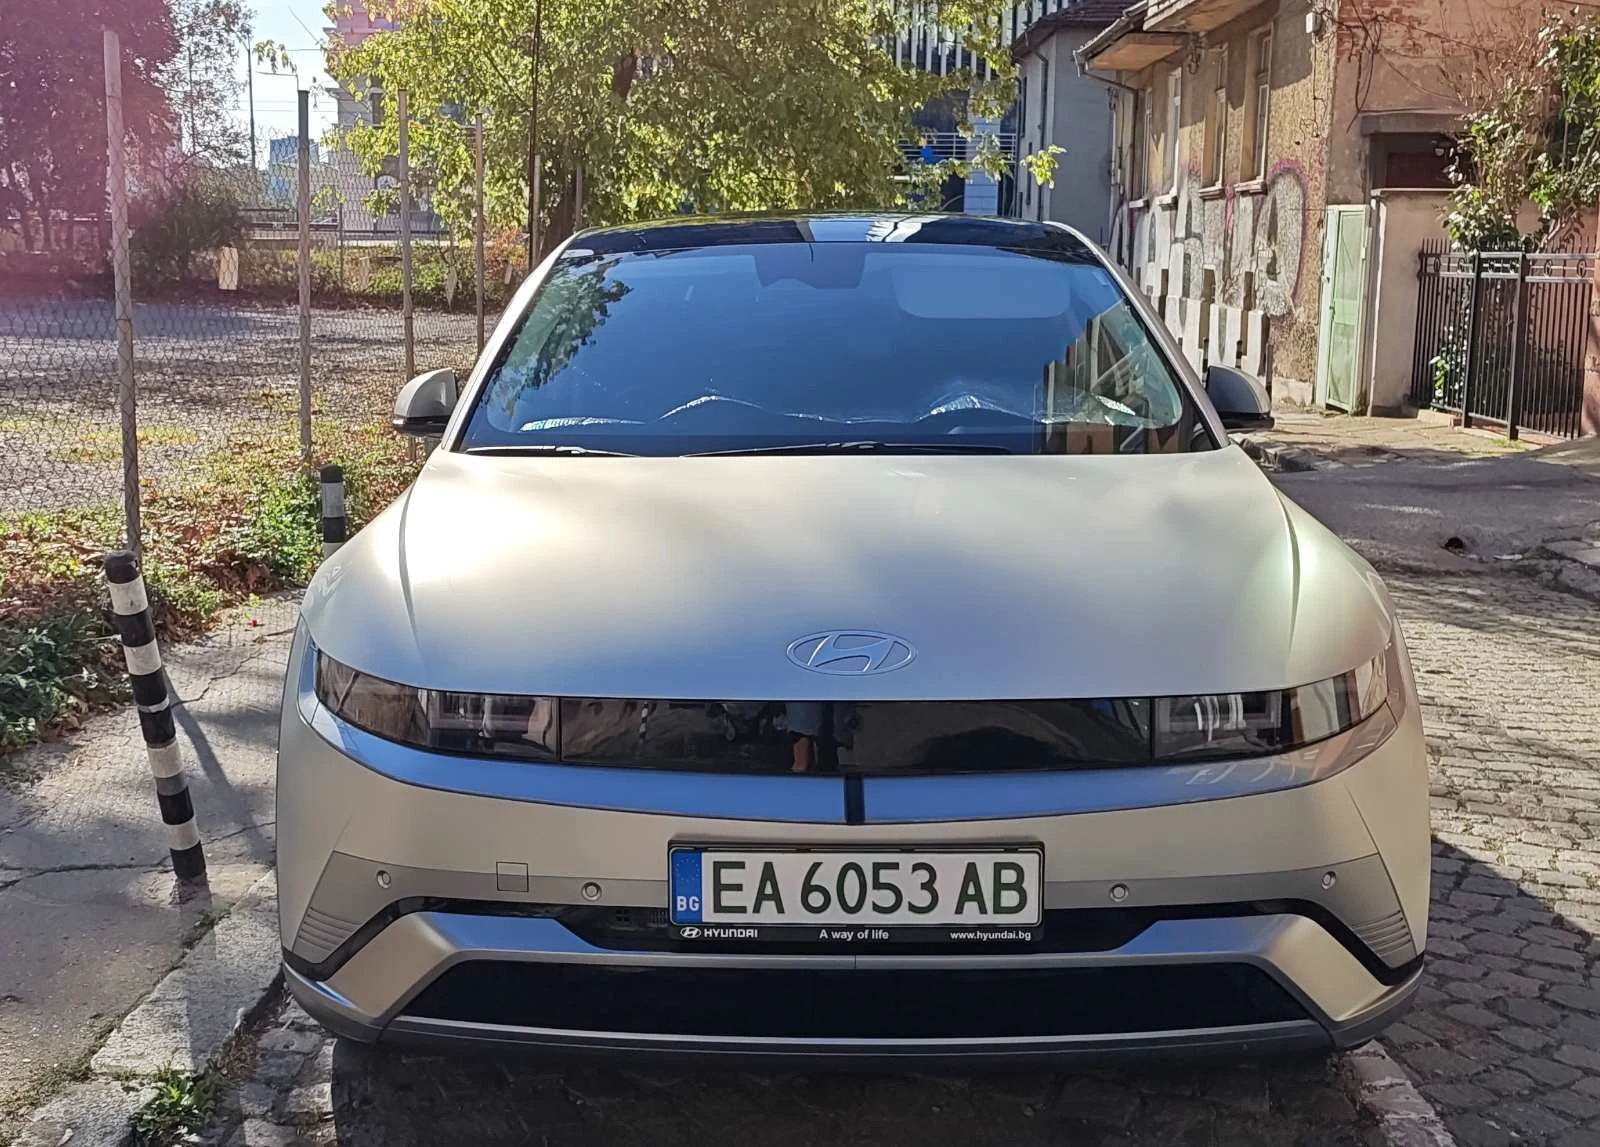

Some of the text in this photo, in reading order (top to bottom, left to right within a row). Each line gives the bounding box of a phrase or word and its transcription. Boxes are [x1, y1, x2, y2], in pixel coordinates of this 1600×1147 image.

[713, 861, 1028, 915] EA 6053 AB
[676, 896, 700, 912] BG
[704, 929, 758, 938] HYUNDAI
[819, 929, 889, 941] A way of life
[950, 930, 1032, 941] www.hyundai.bg
